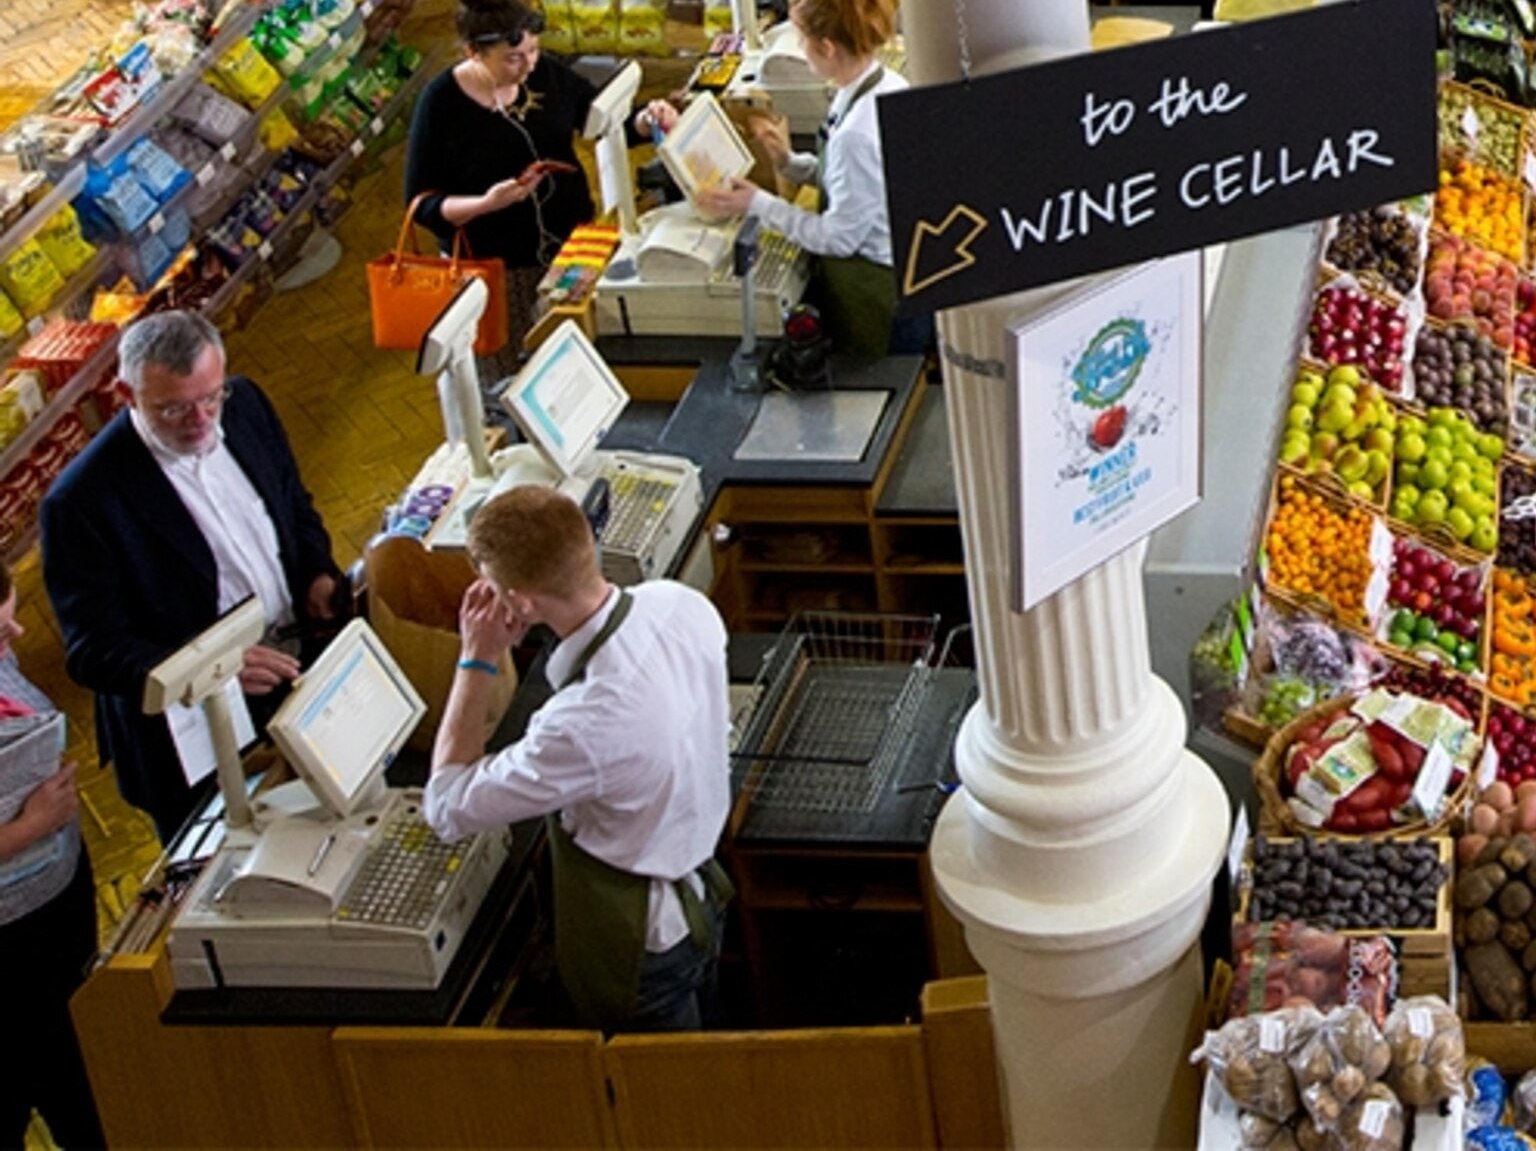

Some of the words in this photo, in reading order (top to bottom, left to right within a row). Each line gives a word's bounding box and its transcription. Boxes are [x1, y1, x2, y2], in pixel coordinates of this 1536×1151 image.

[1081, 93, 1135, 146] to
[1148, 77, 1247, 127] the
[1001, 172, 1156, 250] WINE
[1180, 129, 1394, 207] CELLAR
